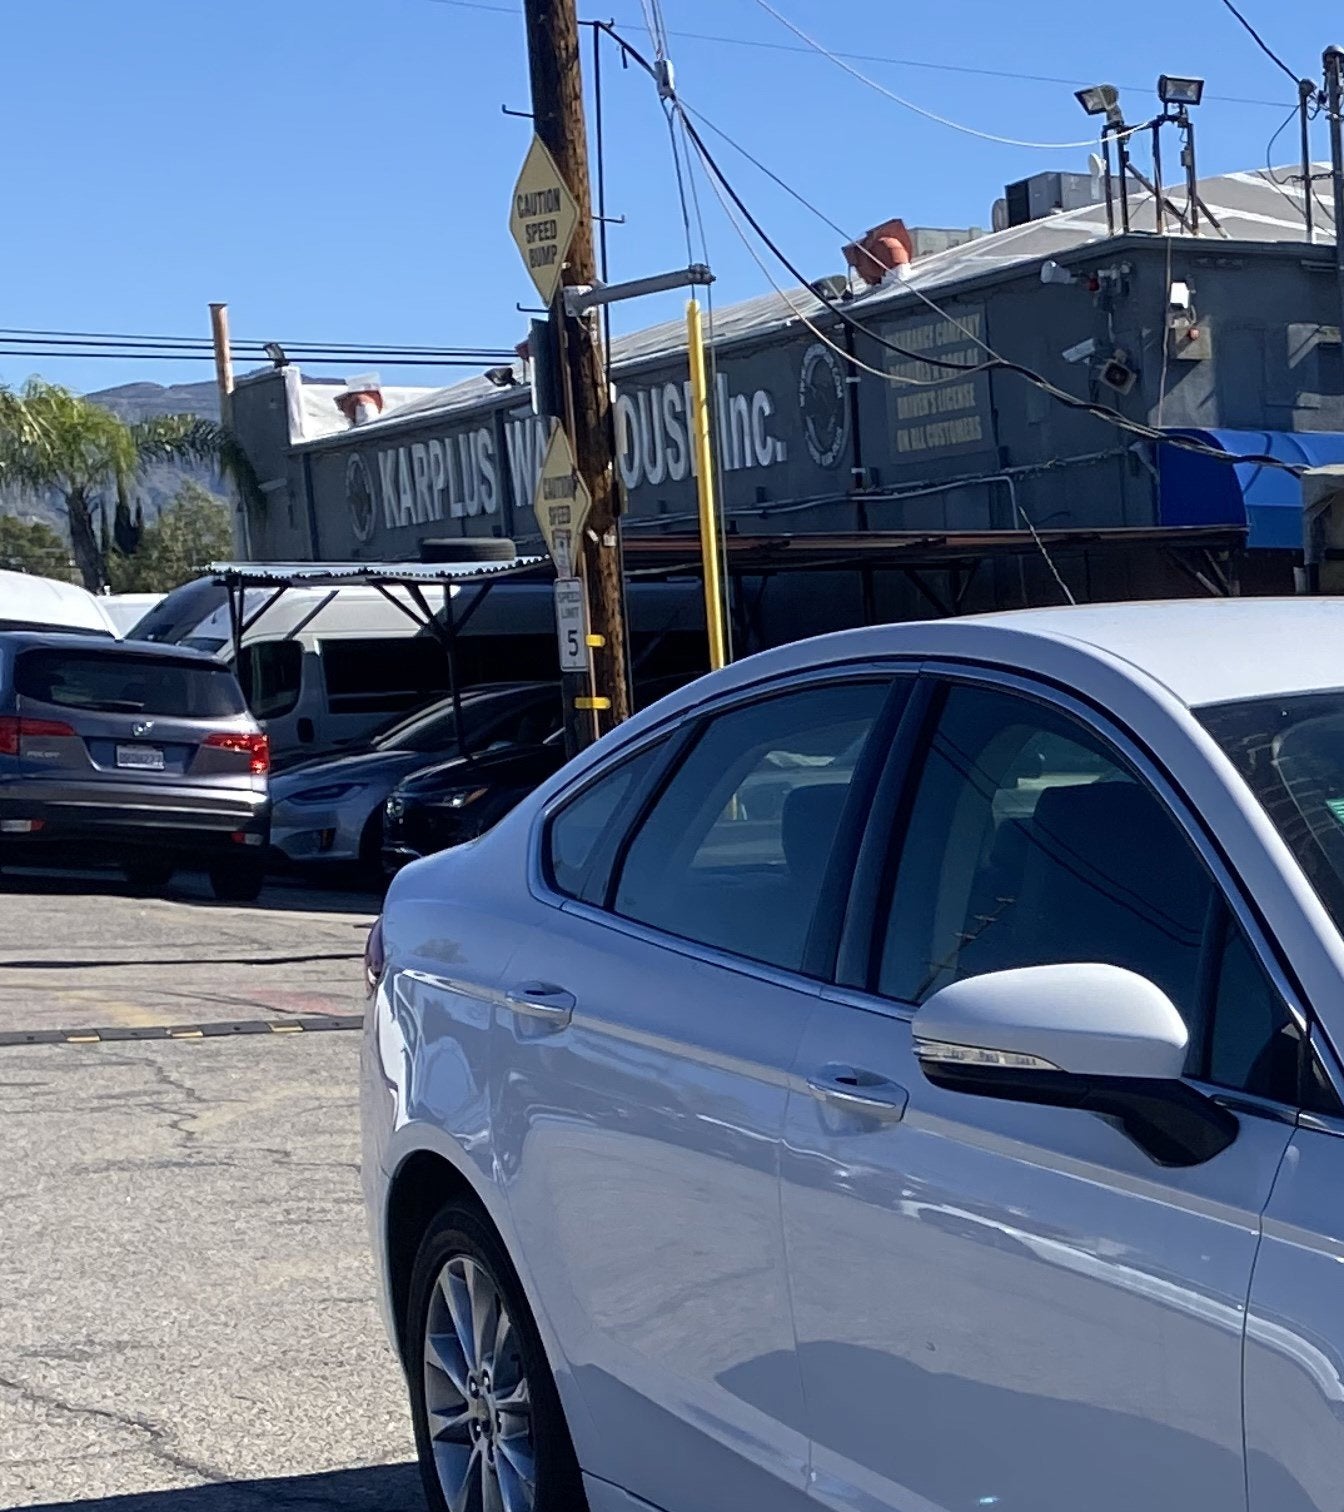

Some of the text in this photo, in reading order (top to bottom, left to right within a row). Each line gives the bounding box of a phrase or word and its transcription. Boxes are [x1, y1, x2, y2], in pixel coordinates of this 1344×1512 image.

[517, 187, 561, 219] CAUTION
[525, 220, 557, 244] SPEED
[529, 245, 557, 269] BUMP
[378, 427, 497, 530] KARPLUS
[716, 371, 788, 471] Inc.
[568, 629, 579, 657] 5
